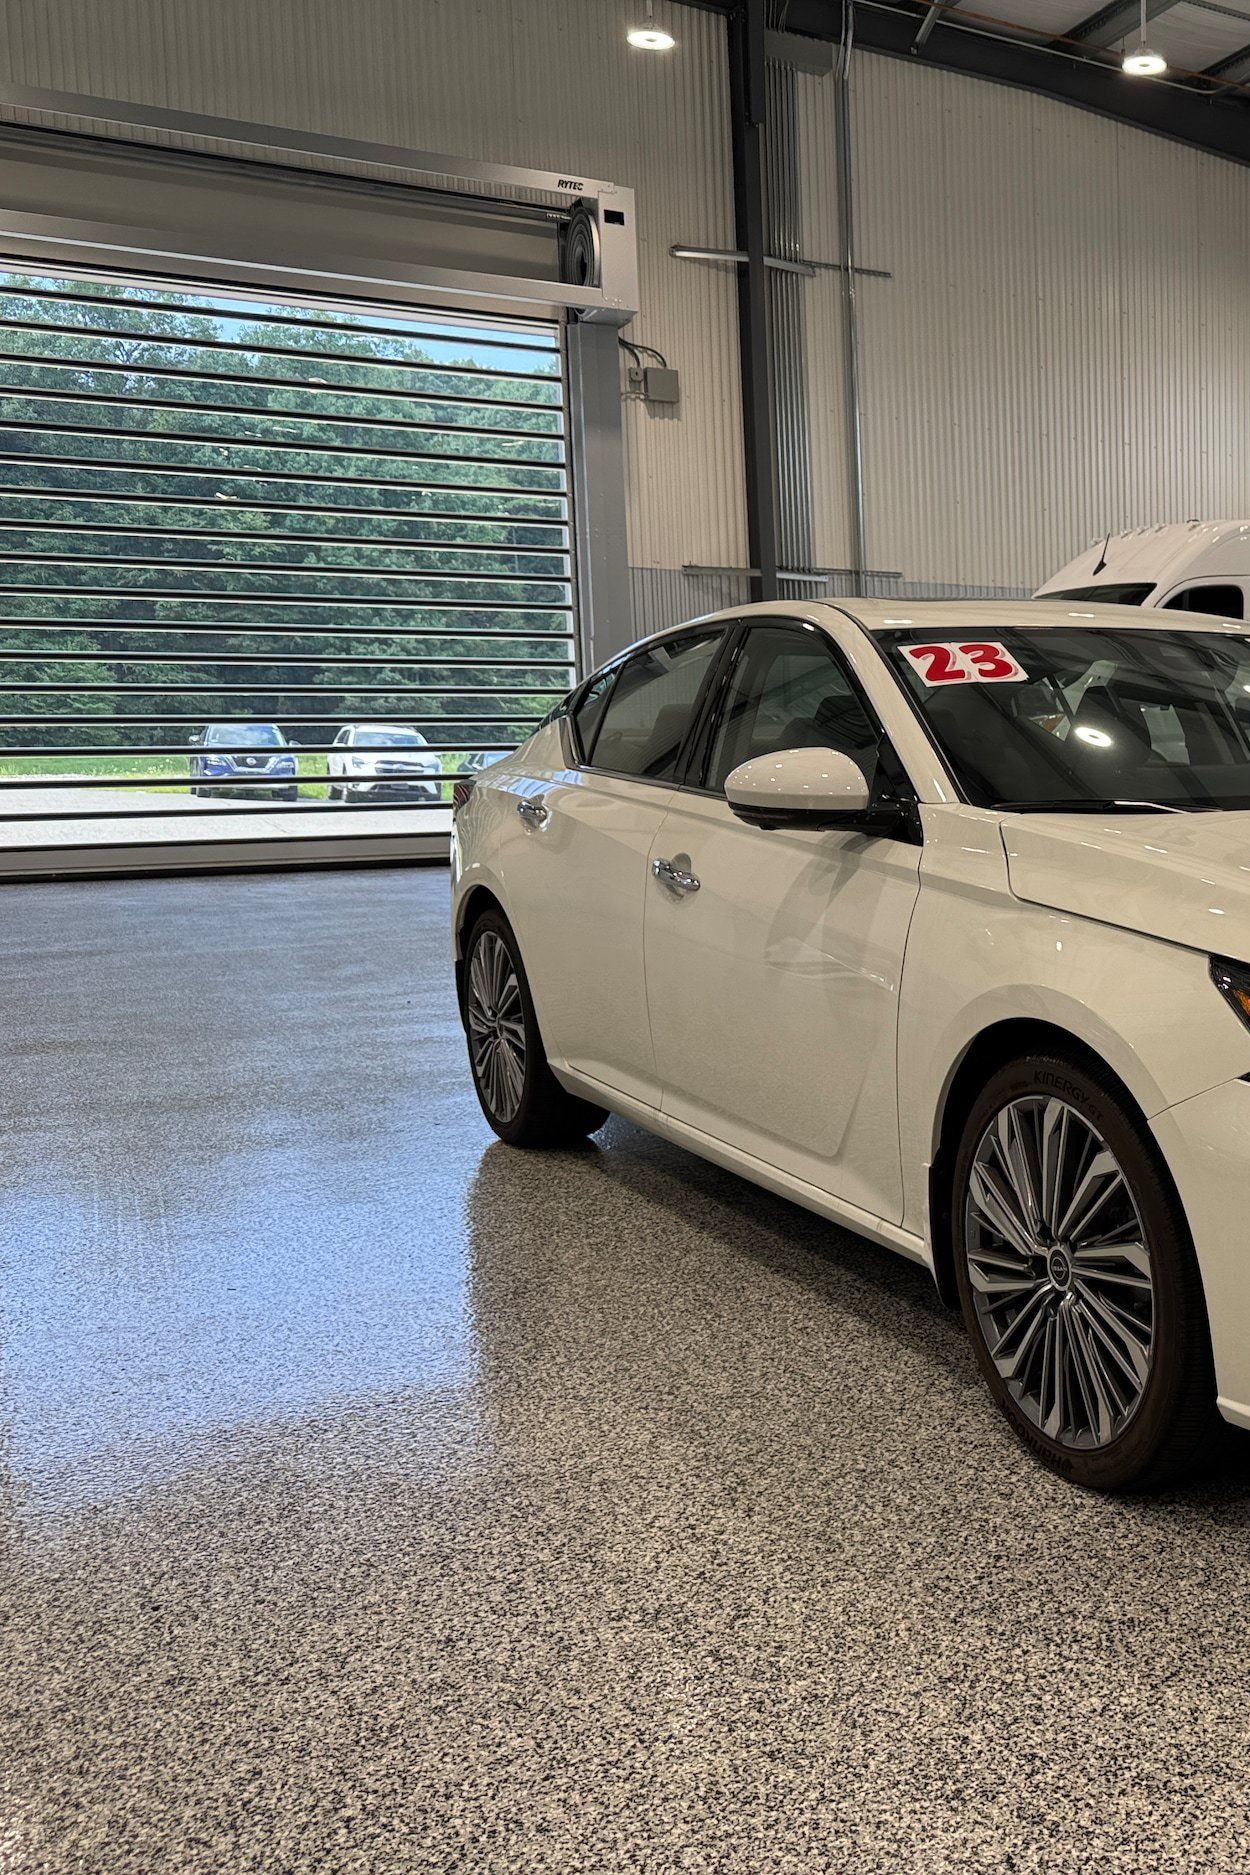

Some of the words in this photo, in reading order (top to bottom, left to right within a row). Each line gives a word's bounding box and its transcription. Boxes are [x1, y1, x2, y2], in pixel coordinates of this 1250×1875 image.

[557, 179, 583, 190] RYTEC
[908, 643, 1016, 682] 23
[1033, 1069, 1091, 1104] KINERGY
